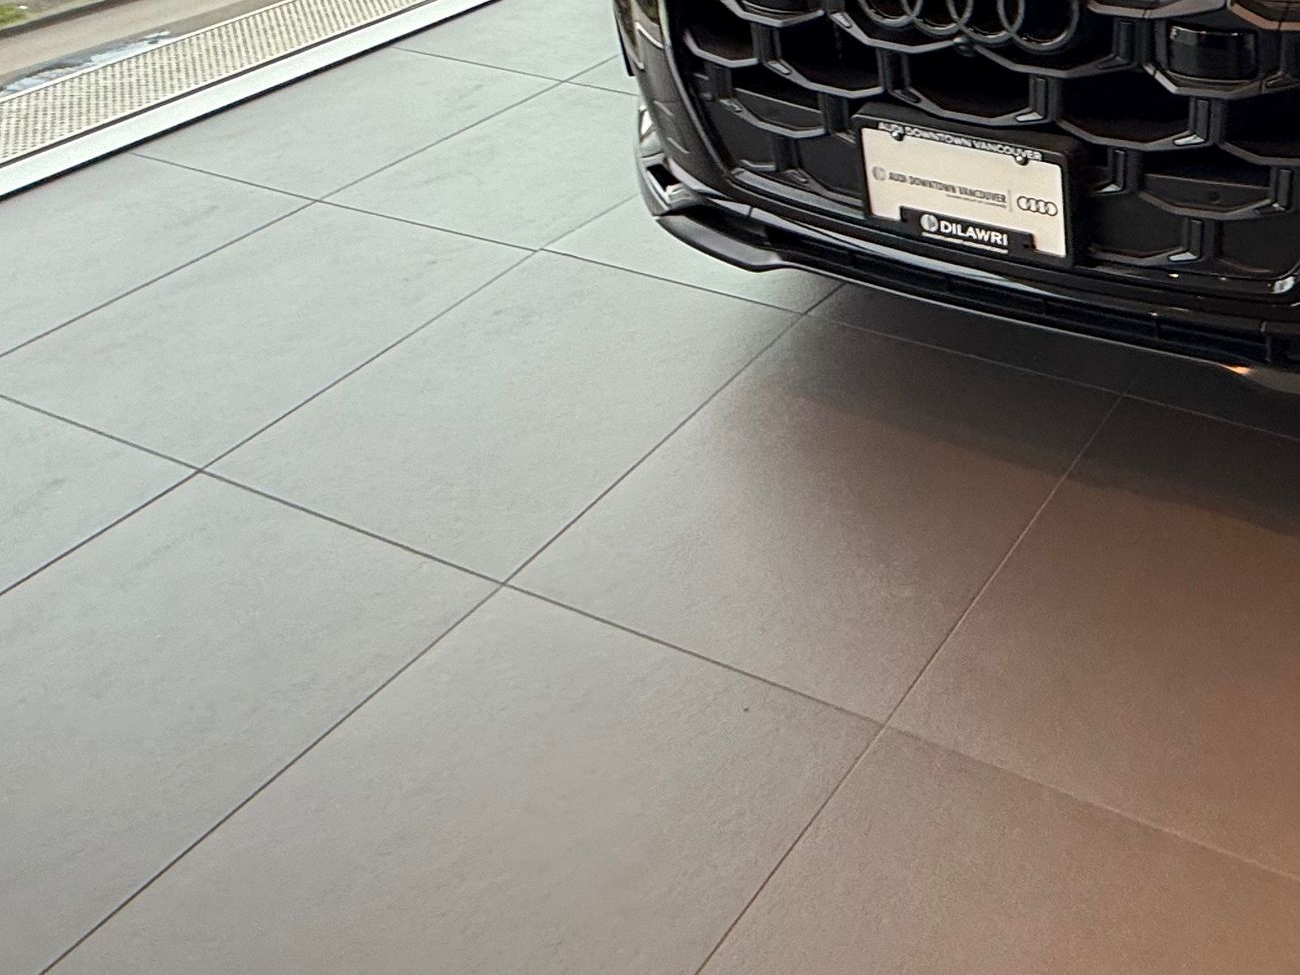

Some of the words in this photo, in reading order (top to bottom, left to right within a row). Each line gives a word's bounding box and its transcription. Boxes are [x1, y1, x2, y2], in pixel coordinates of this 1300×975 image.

[878, 122, 904, 135] AUDI
[904, 126, 973, 147] DOWNTOWN
[972, 139, 1042, 161] VANCOUVER
[888, 171, 907, 184] AUDI
[908, 175, 957, 194] DOWNTOWN
[959, 185, 1007, 203] VANCOUVER
[940, 220, 1009, 246] DILAWRI
